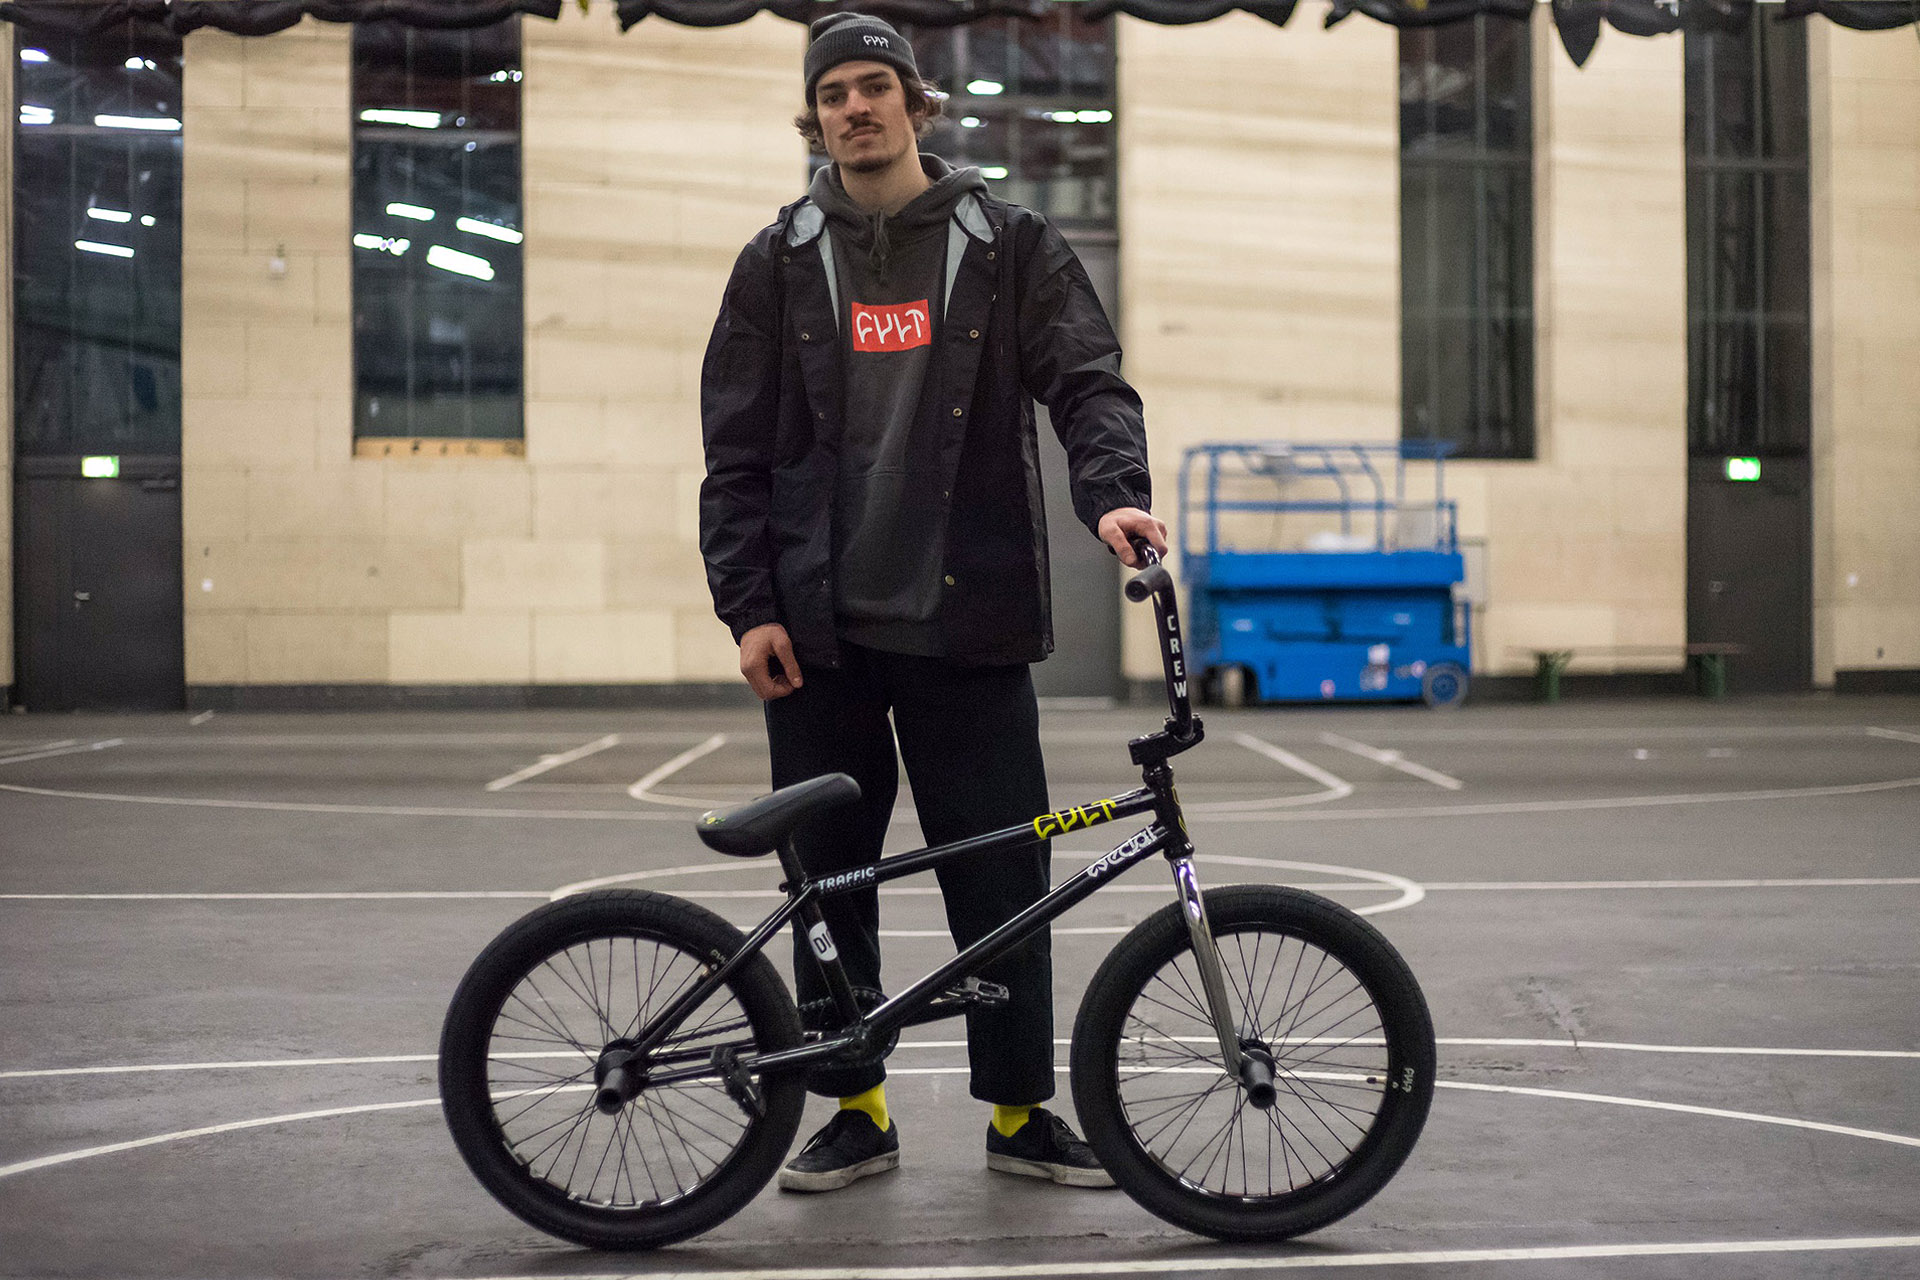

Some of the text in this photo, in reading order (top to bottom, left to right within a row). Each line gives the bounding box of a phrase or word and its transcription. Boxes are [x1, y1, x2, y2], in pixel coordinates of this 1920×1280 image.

[863, 35, 889, 48] CULT
[856, 309, 925, 344] CULT
[1166, 615, 1187, 698] CREW
[1033, 798, 1117, 840] CULT
[818, 866, 876, 890] TRAFFIC
